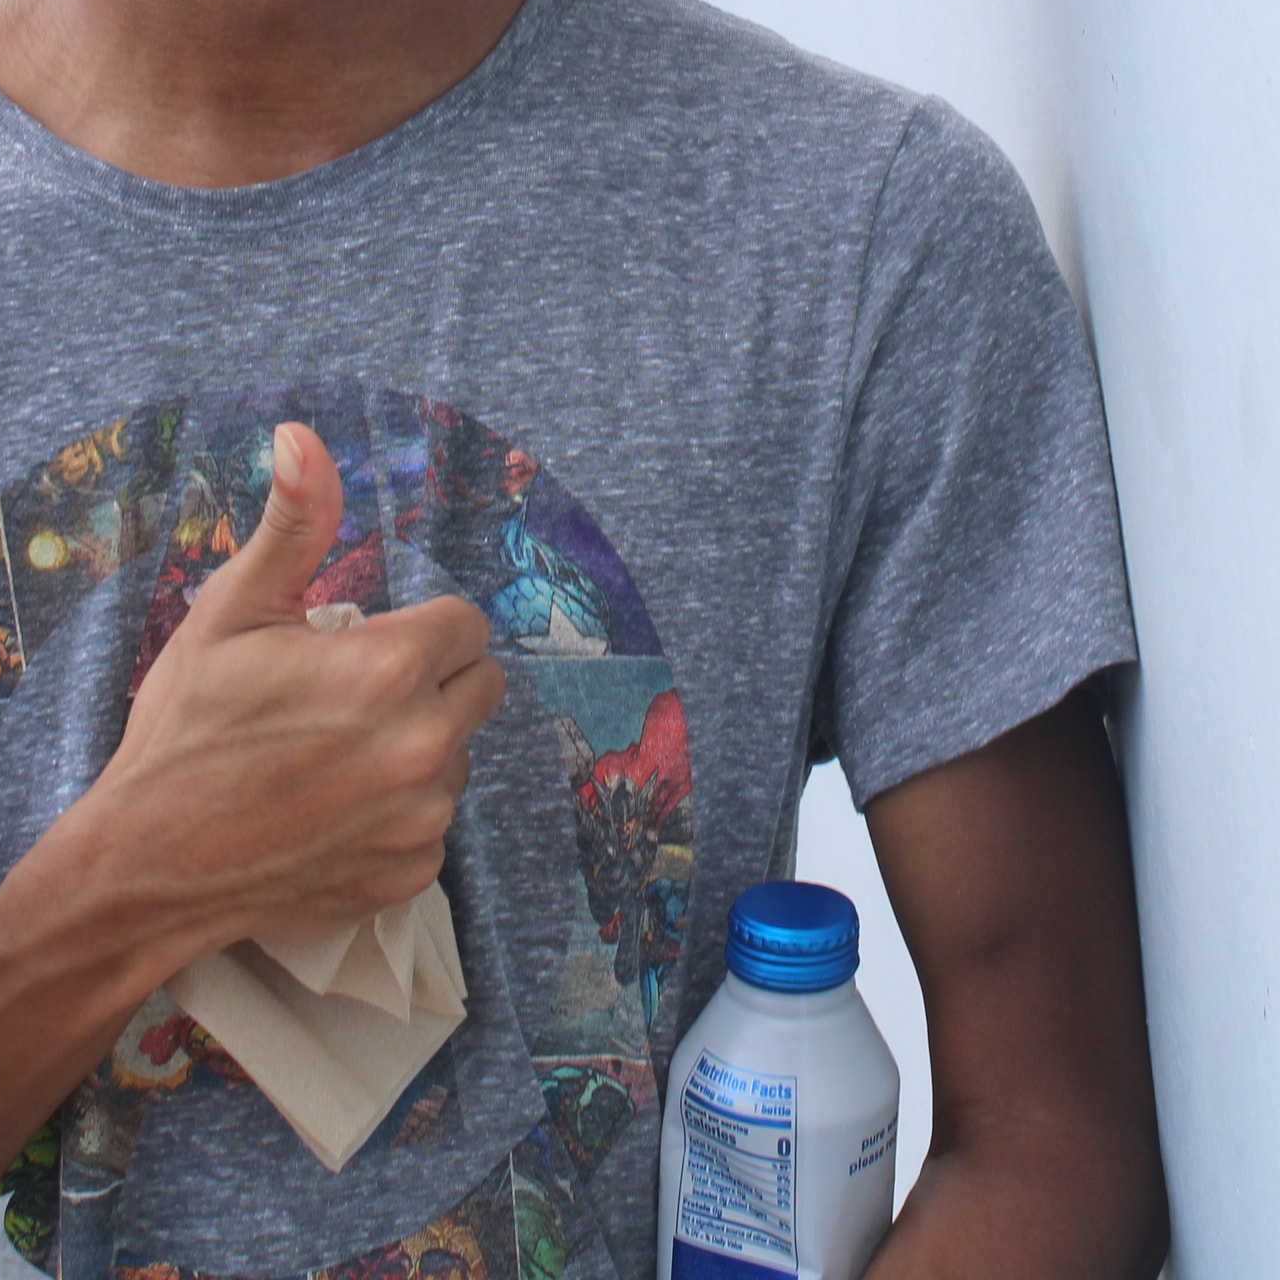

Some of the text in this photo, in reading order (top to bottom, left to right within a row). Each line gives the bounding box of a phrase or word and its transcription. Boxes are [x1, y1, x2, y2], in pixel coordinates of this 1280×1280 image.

[697, 1055, 792, 1099] Nutrition Facts
[689, 1076, 715, 1101] Serving
[717, 1094, 734, 1107] size
[761, 1104, 791, 1116] bottle
[685, 1110, 791, 1157] Calories 0
[721, 1119, 749, 1136] serving
[862, 1127, 885, 1152] pure
[688, 1160, 707, 1171] Total
[849, 1145, 884, 1176] please
[691, 1174, 708, 1185] Total
[682, 1197, 712, 1212] Protein
